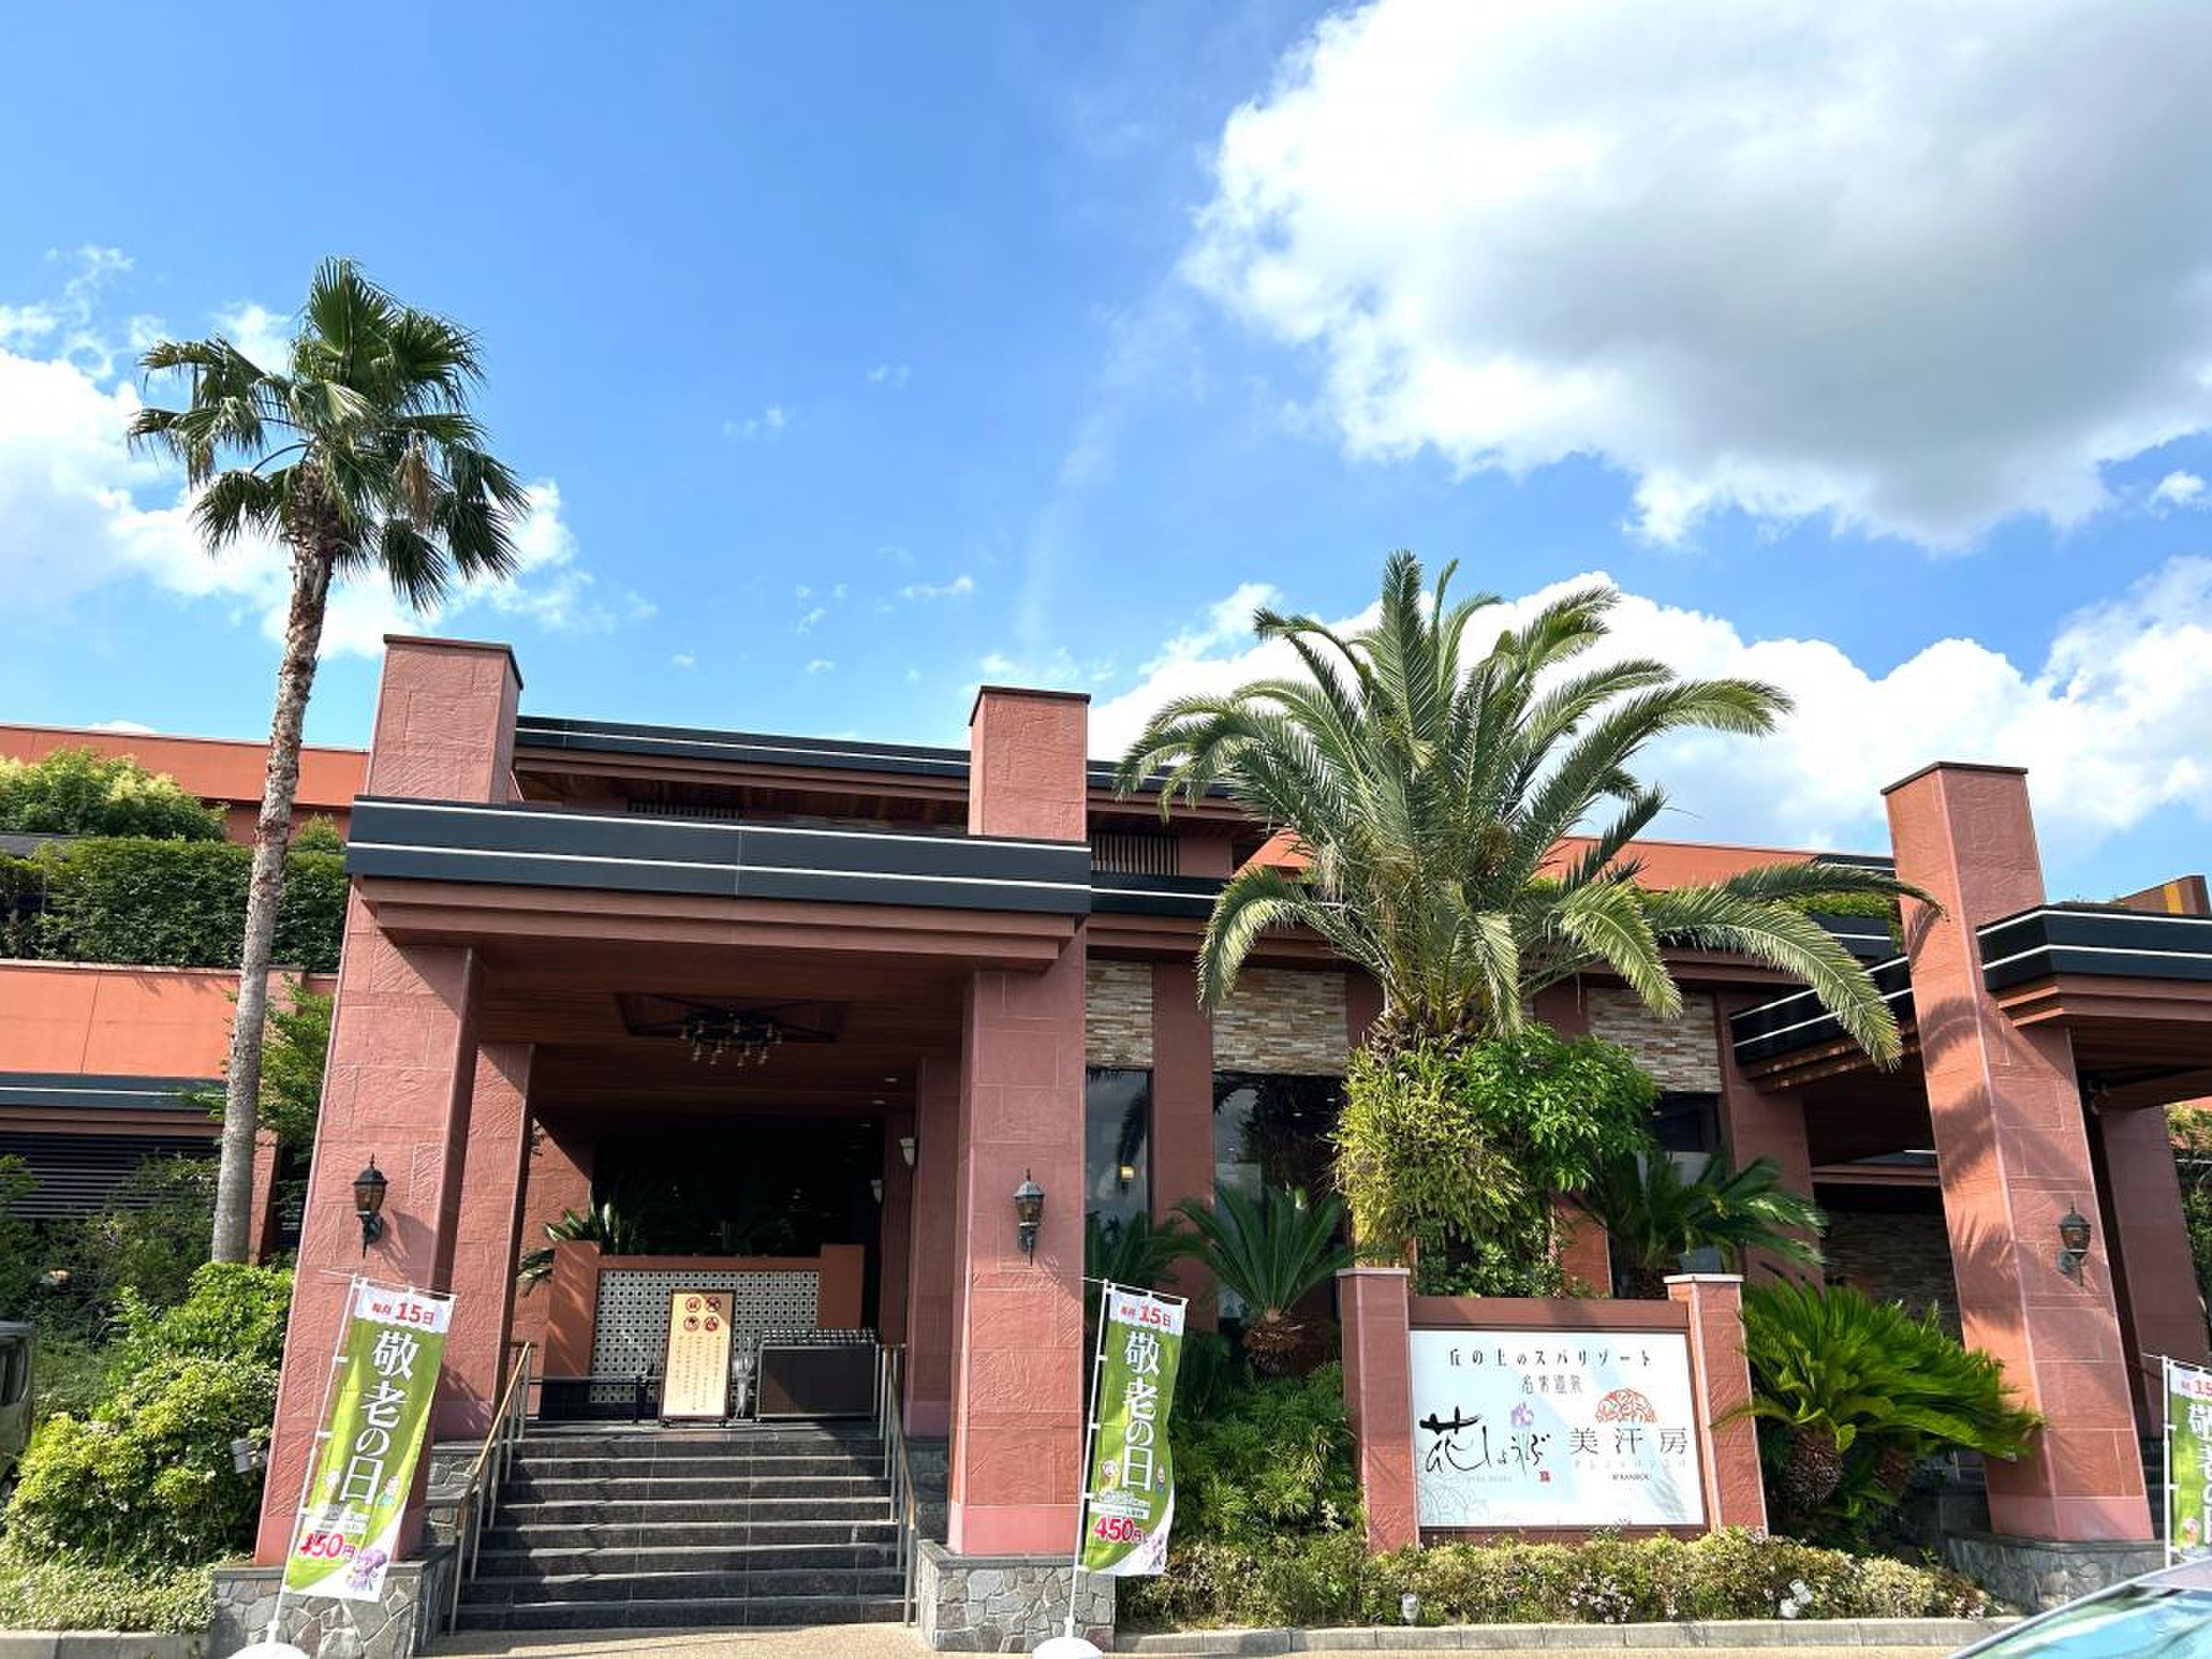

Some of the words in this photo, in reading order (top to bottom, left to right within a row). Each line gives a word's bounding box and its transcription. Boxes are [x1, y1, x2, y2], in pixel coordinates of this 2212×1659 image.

[337, 1330, 420, 1505] 敬老の日
[1122, 1331, 1160, 1491] 敬老の日
[1570, 1427, 1688, 1455] 美汗房
[1093, 1517, 1142, 1542] 450円
